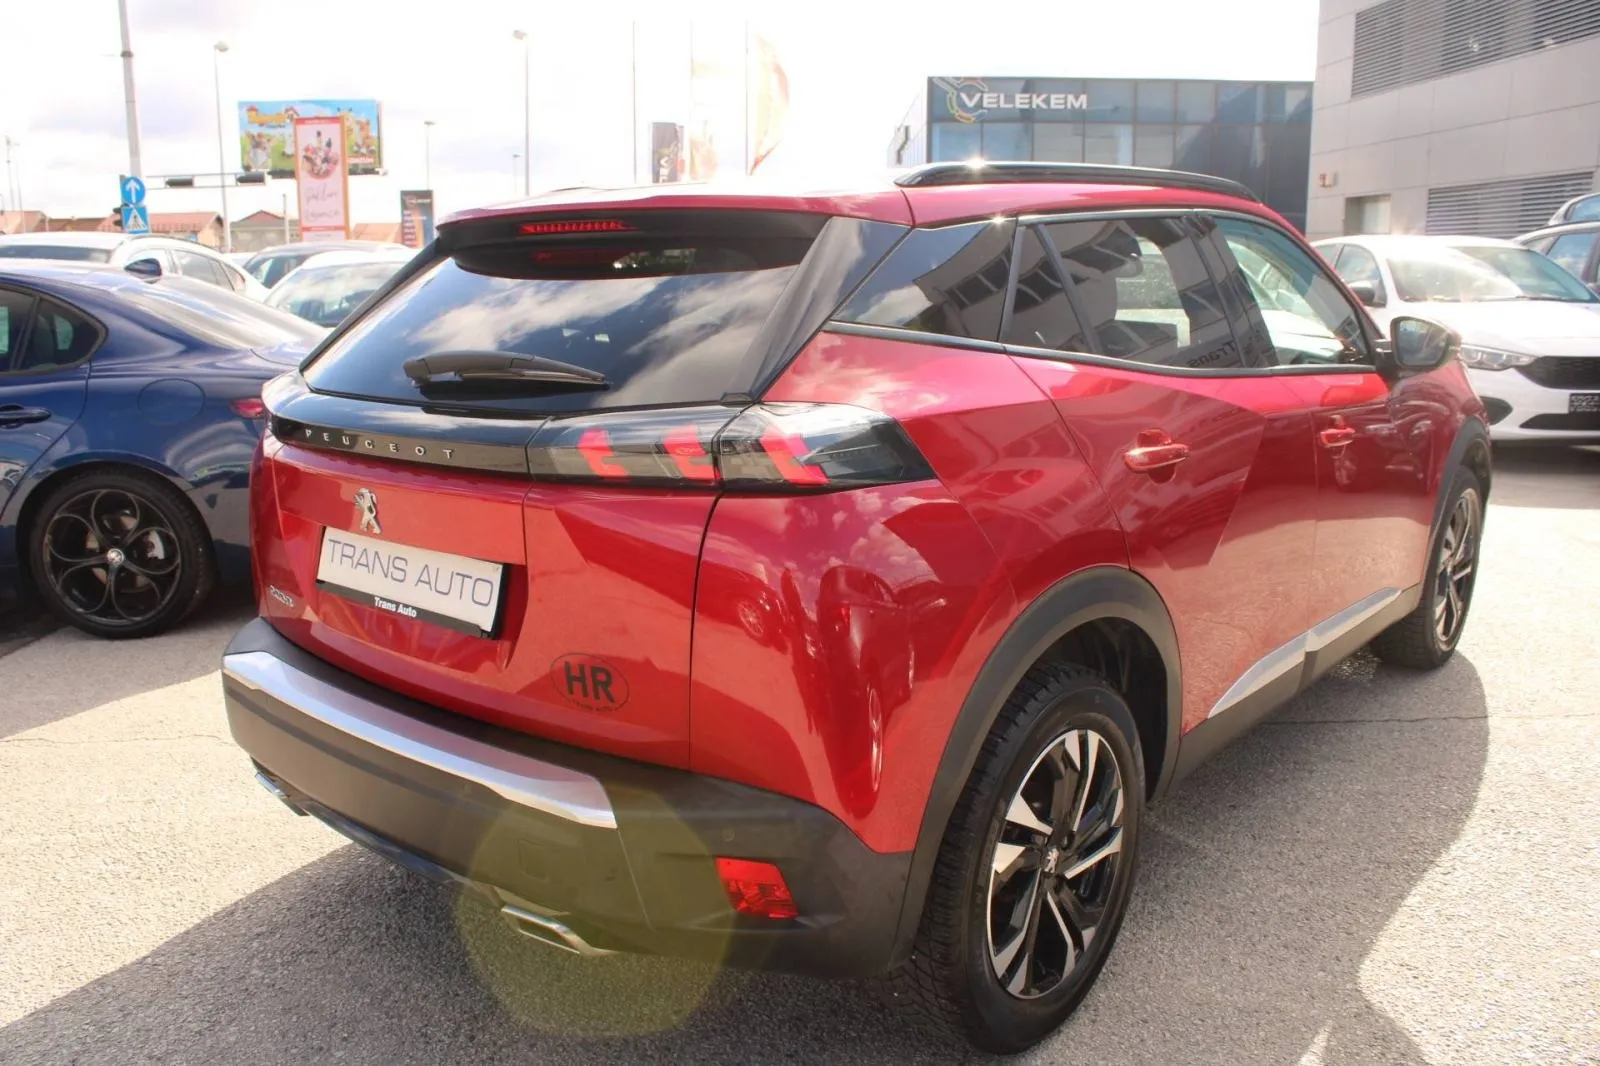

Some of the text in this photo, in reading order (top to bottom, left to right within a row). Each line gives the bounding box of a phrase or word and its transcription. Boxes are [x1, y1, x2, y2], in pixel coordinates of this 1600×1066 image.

[959, 92, 1087, 109] VELEKEM
[305, 429, 452, 459] PEUGEOT
[328, 539, 494, 607] TRANS AUTO
[374, 596, 417, 618] Trans Auto
[564, 660, 616, 703] HR
